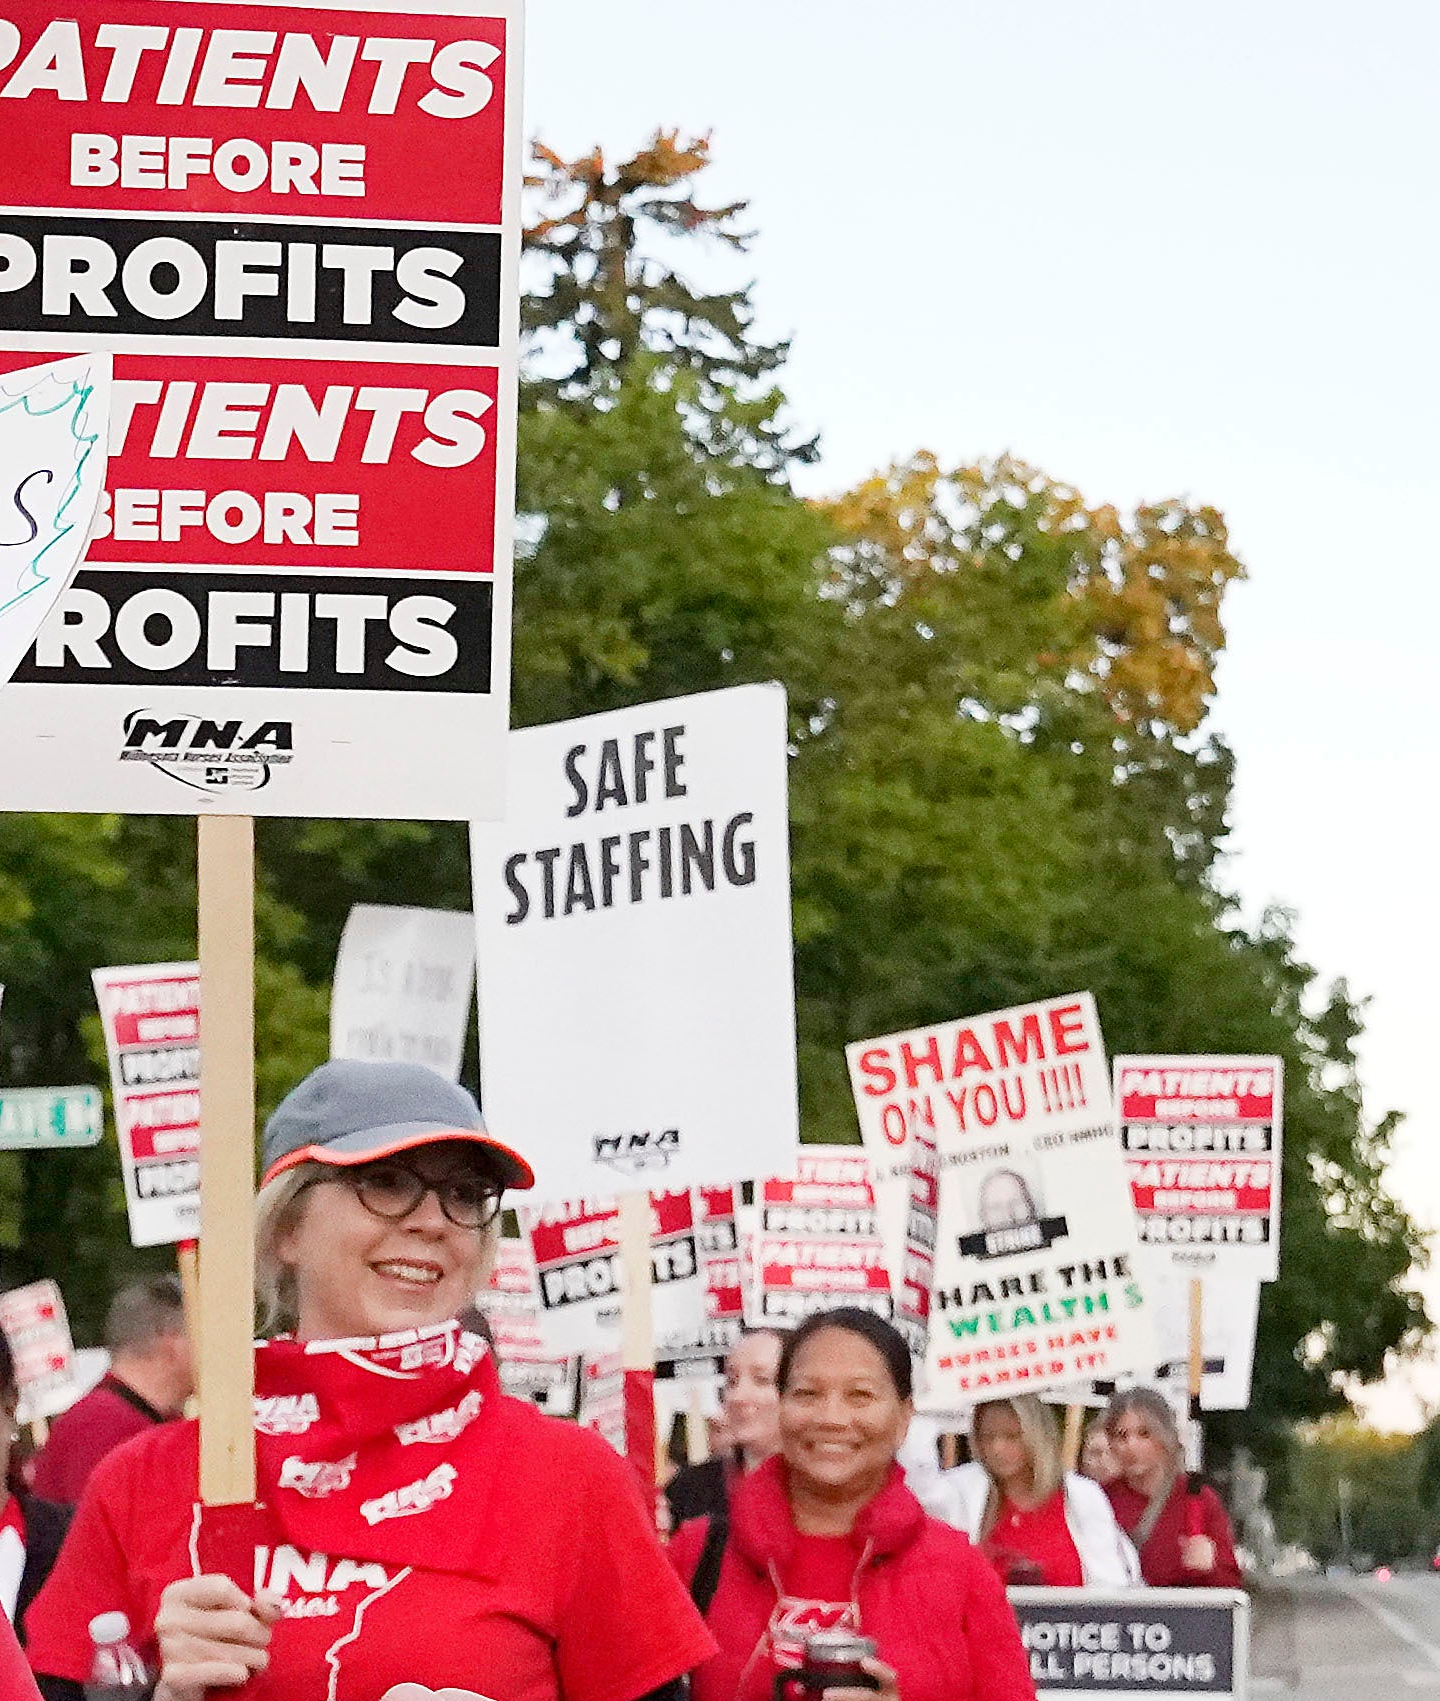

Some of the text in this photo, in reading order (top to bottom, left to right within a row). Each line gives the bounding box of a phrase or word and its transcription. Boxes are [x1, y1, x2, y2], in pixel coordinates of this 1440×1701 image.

[70, 133, 367, 198] BEFORE
[36, 588, 457, 678] ROFITS
[125, 719, 292, 750] MNA
[565, 725, 687, 817] SAFE
[504, 812, 756, 926] STAFFING
[859, 1004, 1089, 1097] SHAME
[946, 1075, 1027, 1134] YOU
[938, 1271, 1047, 1310] HARE
[1059, 1253, 1130, 1288] THE
[1030, 1652, 1067, 1680] LL
[1126, 1622, 1172, 1652] TO
